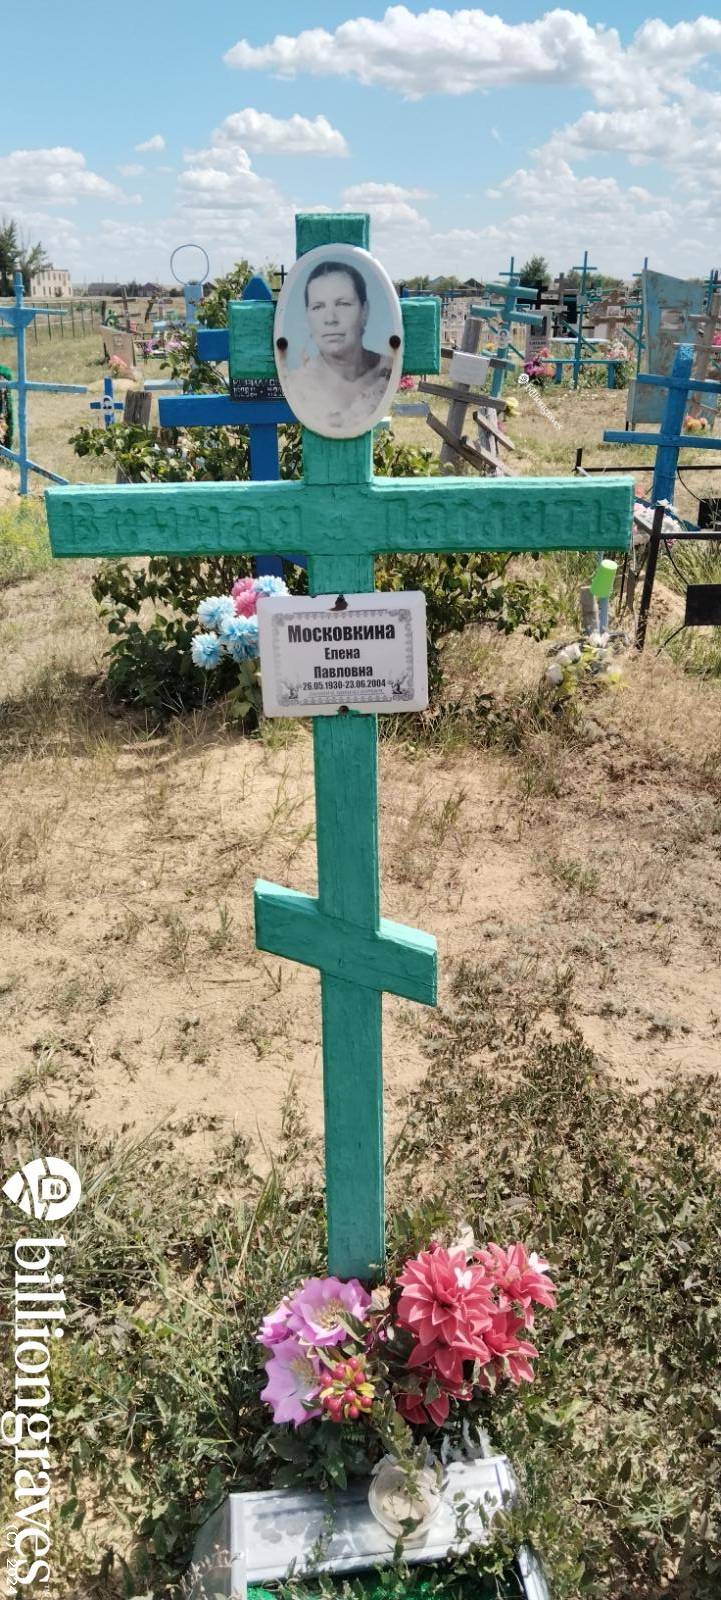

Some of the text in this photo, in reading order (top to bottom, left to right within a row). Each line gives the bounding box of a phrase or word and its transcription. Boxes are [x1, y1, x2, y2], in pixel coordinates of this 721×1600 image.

[287, 624, 396, 643] Московкина
[324, 647, 361, 660] Елена
[313, 665, 374, 679] Павловна
